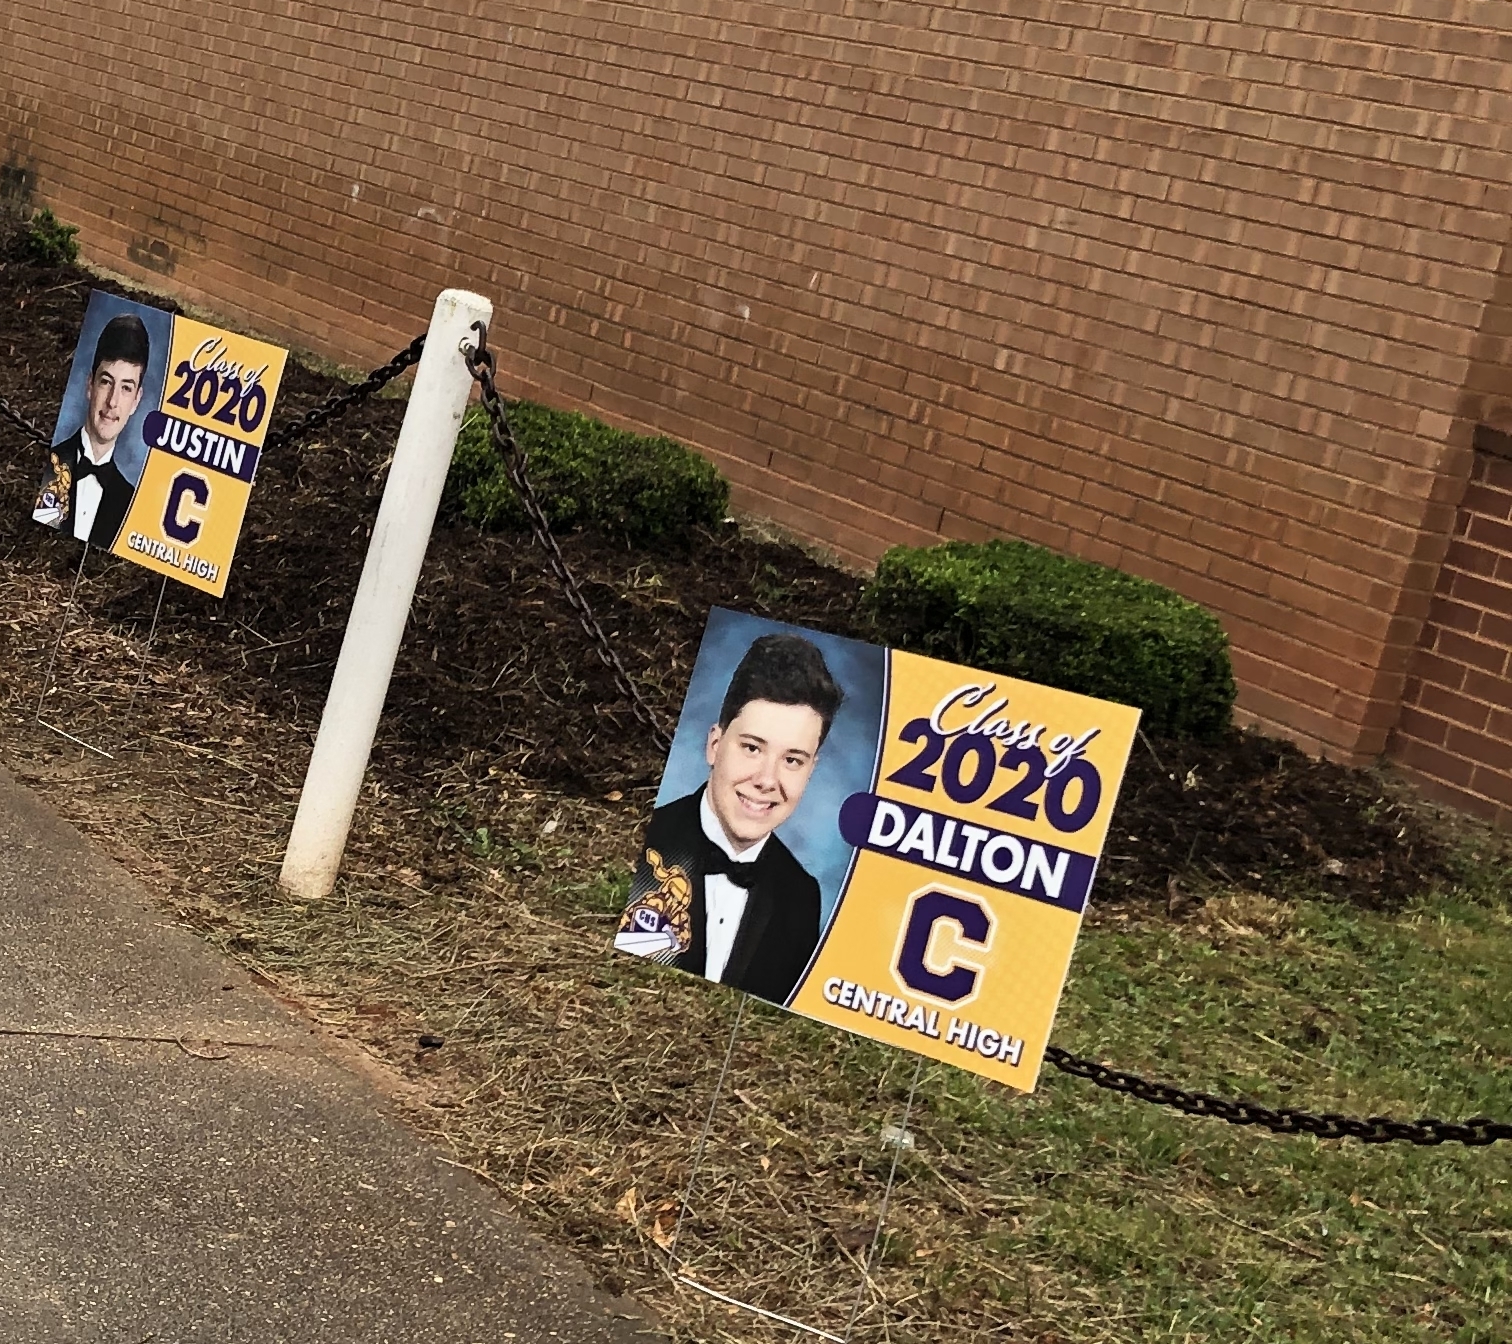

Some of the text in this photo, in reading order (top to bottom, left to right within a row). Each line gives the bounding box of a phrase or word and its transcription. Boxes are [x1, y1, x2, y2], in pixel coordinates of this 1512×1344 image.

[166, 360, 267, 434] 2020
[189, 336, 269, 398] Class of
[156, 417, 247, 475] JUSTIN
[161, 470, 210, 547] C
[127, 530, 221, 583] CENTRAL HIGH
[929, 681, 1102, 778] Class of
[884, 717, 1102, 834] 2020
[867, 799, 1071, 900] DALTON
[638, 909, 656, 928] CHS
[894, 886, 994, 1006] C
[822, 976, 1025, 1067] CENTRAL HIGH
